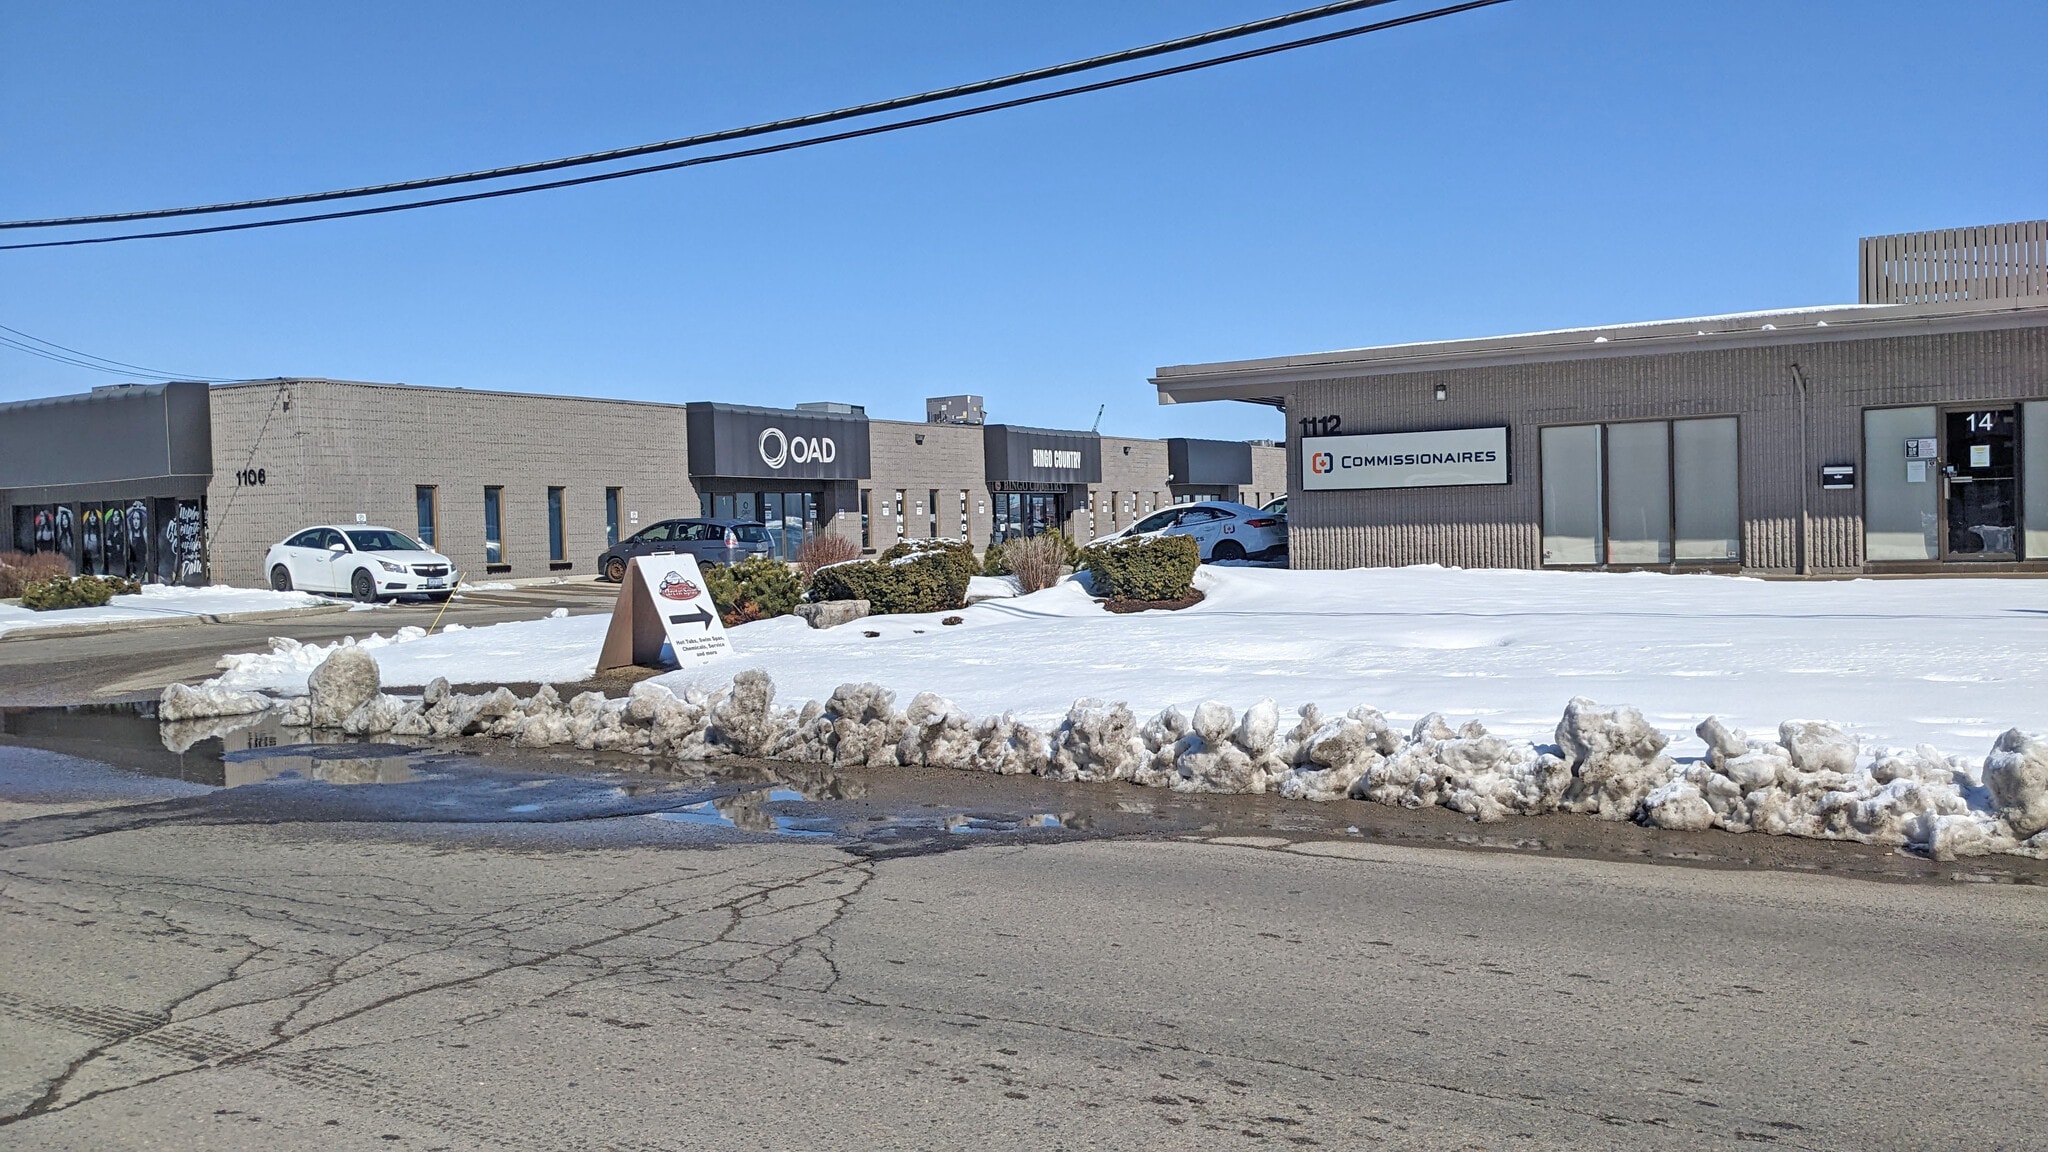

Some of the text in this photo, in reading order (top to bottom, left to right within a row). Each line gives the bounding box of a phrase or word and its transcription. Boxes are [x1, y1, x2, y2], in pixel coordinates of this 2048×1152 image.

[1299, 414, 1342, 436] 1112
[1966, 413, 1993, 431] 14
[790, 436, 836, 464] OAD
[1032, 449, 1081, 469] BINGO COUNTRY
[1341, 451, 1496, 469] COMMISSIONAIRES
[235, 468, 266, 486] 1106
[960, 491, 968, 542] BINGO
